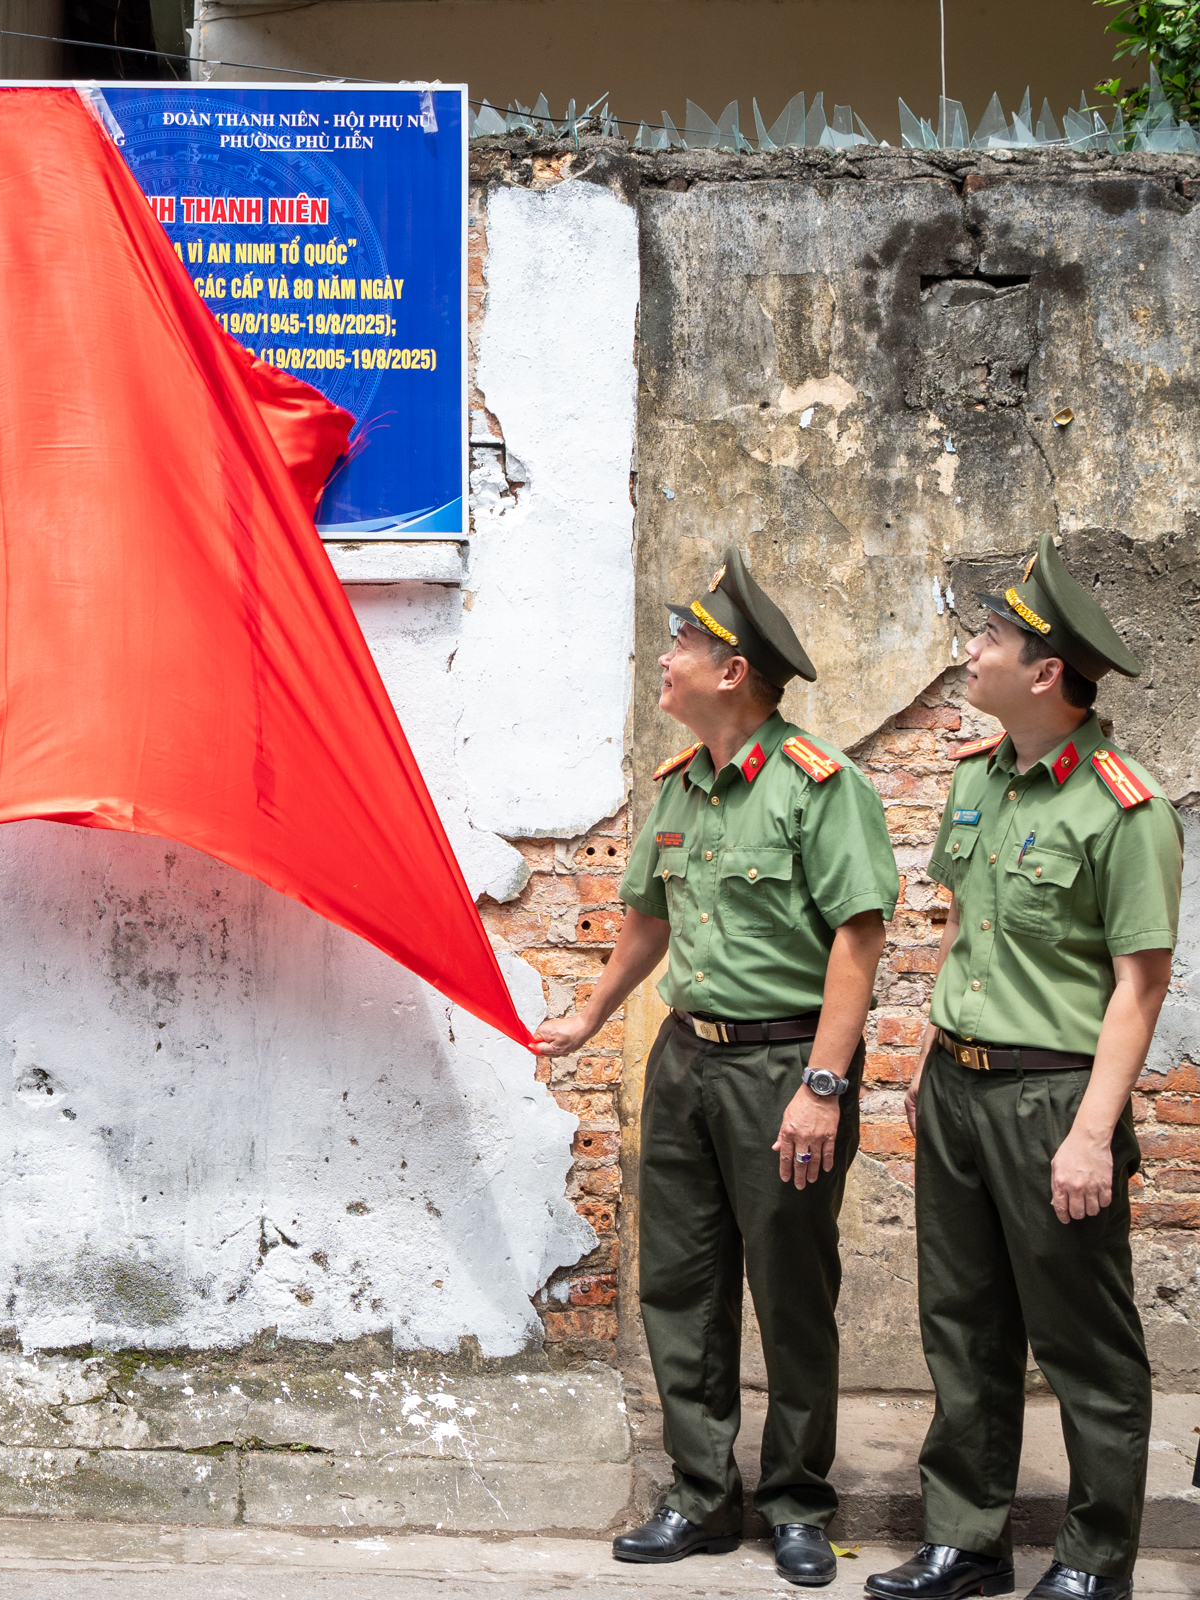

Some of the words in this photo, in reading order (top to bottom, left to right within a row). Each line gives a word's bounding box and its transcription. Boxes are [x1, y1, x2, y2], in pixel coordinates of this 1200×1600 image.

[163, 109, 210, 127] ĐOÀN
[215, 113, 275, 127] THANH
[280, 110, 320, 127] NIÊN
[333, 111, 365, 131] HỘI
[369, 114, 403, 131] PHỤ
[407, 111, 431, 128] NỮ
[220, 132, 292, 149] PHƯỜNG
[296, 131, 330, 148] PHÙ
[334, 130, 373, 149] LIỄN
[181, 196, 263, 225] THANH
[268, 193, 329, 225] NIÊN
[187, 239, 203, 263] VÌ
[208, 243, 231, 264] AN
[236, 243, 276, 264] NINH
[280, 236, 301, 264] TỔ
[195, 273, 227, 299] CÁC
[232, 271, 264, 299] CẤP
[267, 275, 290, 299] VÀ
[294, 279, 314, 299] 80
[318, 276, 356, 300] NĂM
[360, 275, 405, 300] NGÀY
